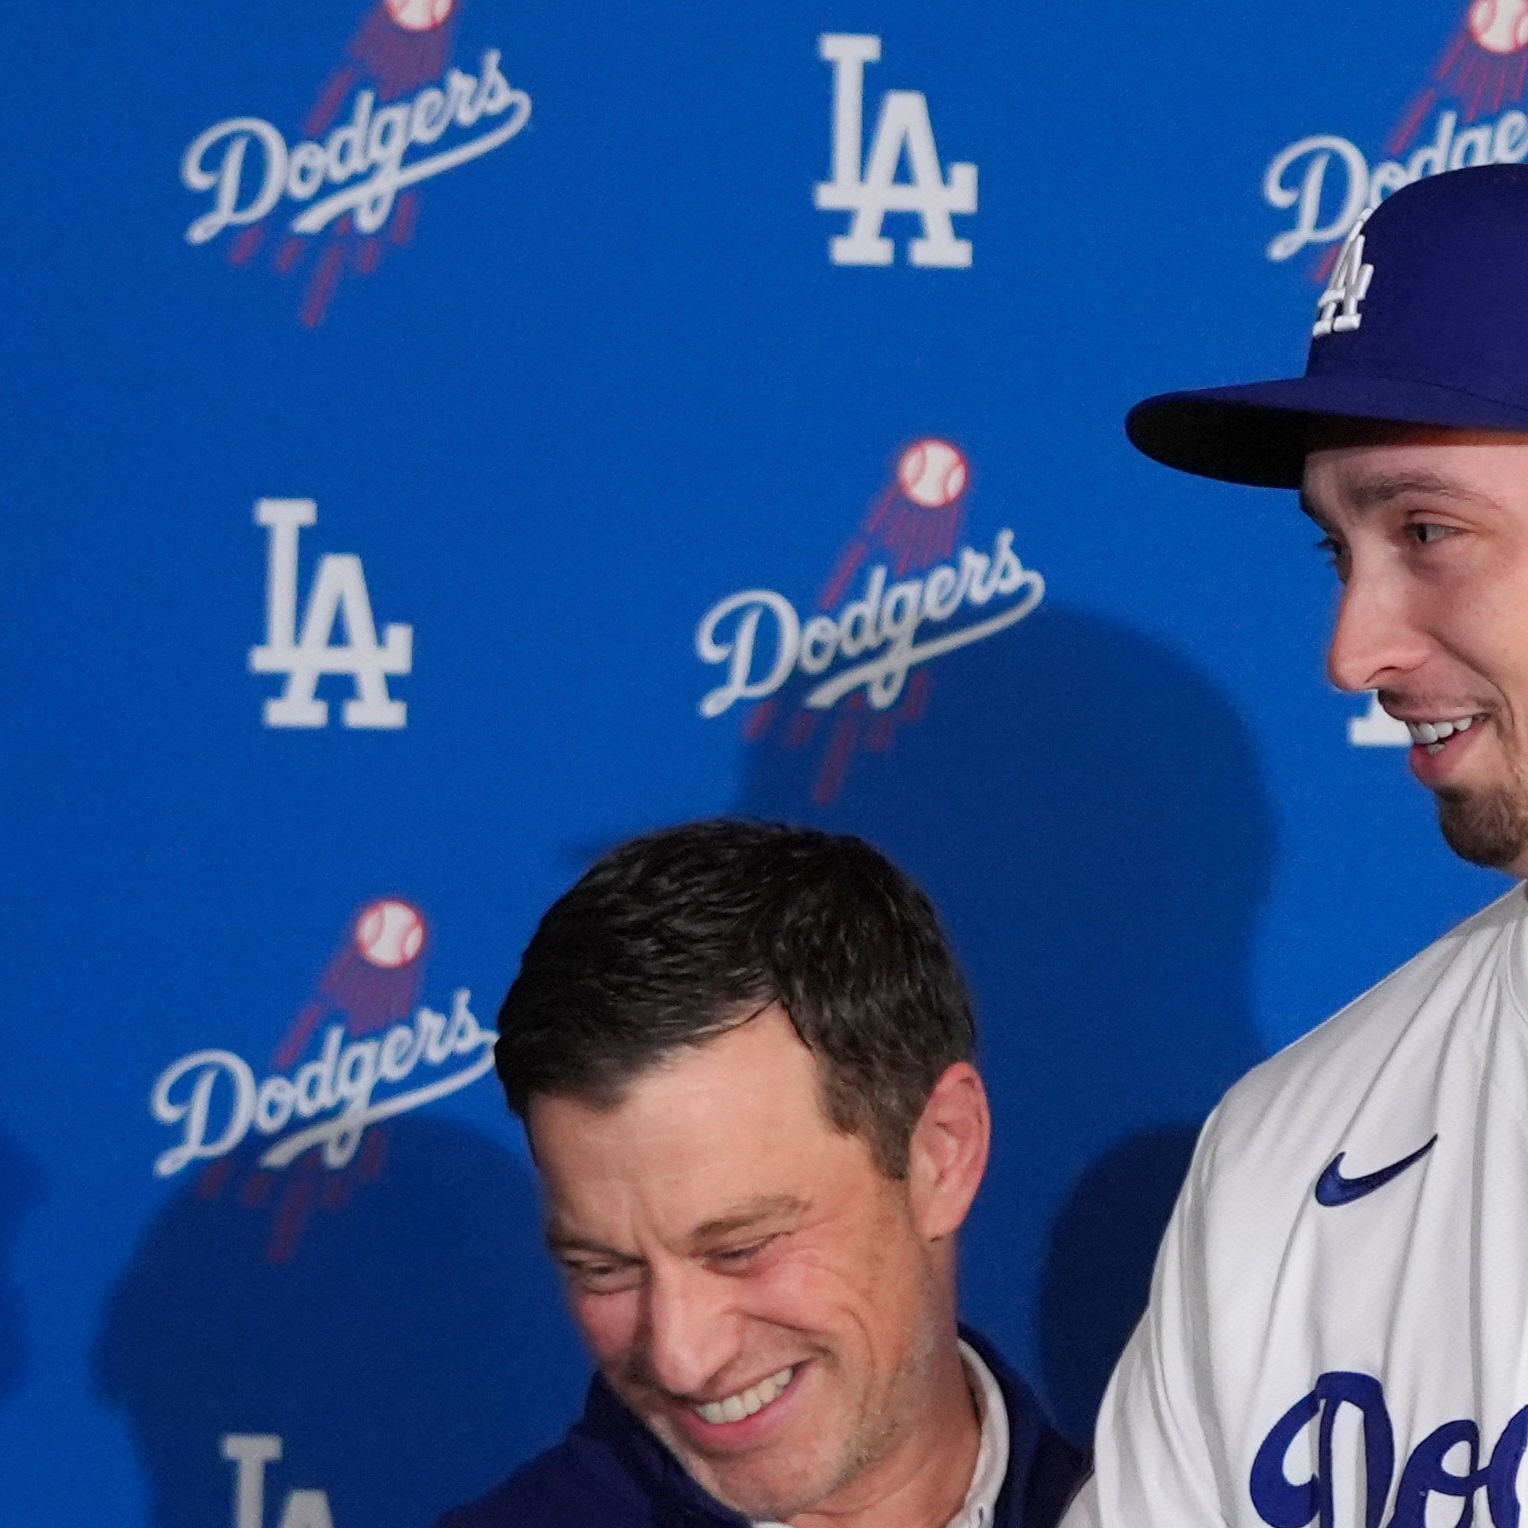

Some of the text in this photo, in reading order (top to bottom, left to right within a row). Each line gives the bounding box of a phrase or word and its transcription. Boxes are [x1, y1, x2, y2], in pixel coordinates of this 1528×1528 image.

[183, 50, 532, 244] Dodgers
[815, 34, 978, 268] LA
[250, 498, 413, 729] LA
[696, 529, 1046, 718] Dodgers
[152, 990, 497, 1177] Dodgers
